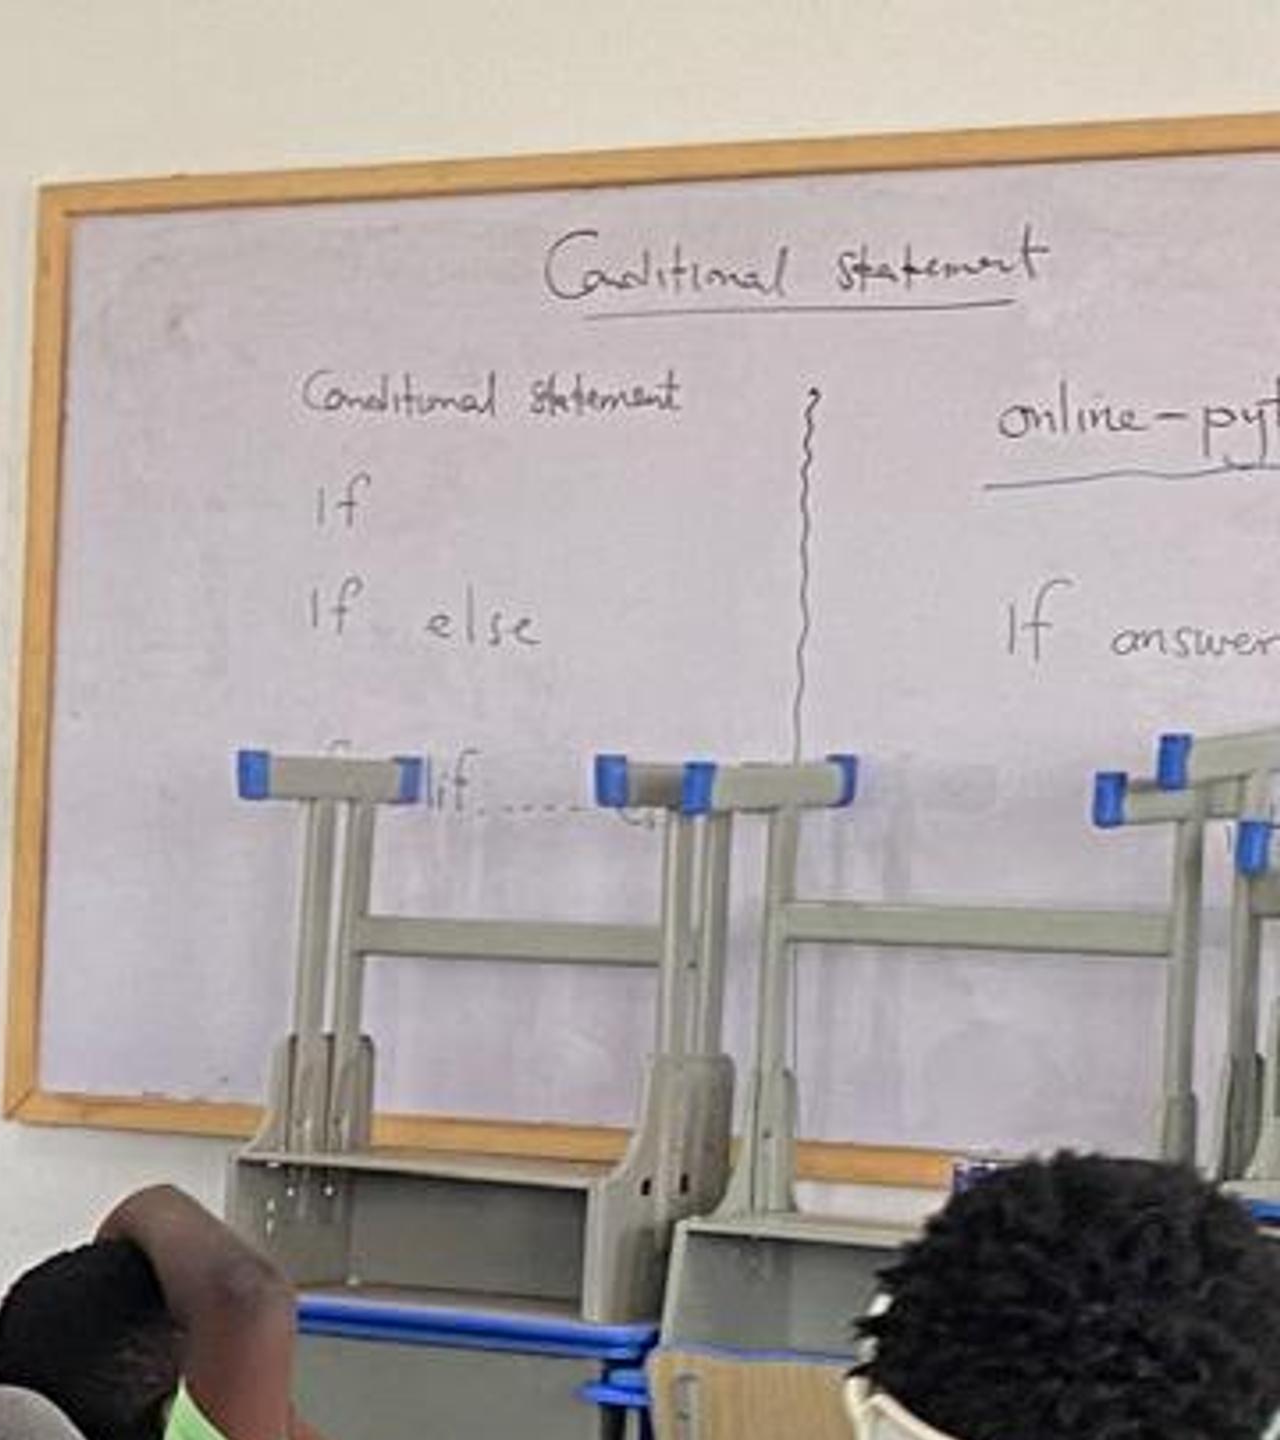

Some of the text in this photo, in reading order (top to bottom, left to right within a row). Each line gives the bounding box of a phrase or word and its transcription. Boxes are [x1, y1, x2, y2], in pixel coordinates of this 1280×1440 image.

[302, 369, 683, 417] Conditional statement
[316, 471, 372, 528] If
[310, 575, 542, 647] If else
[1007, 578, 1280, 663] If answer
